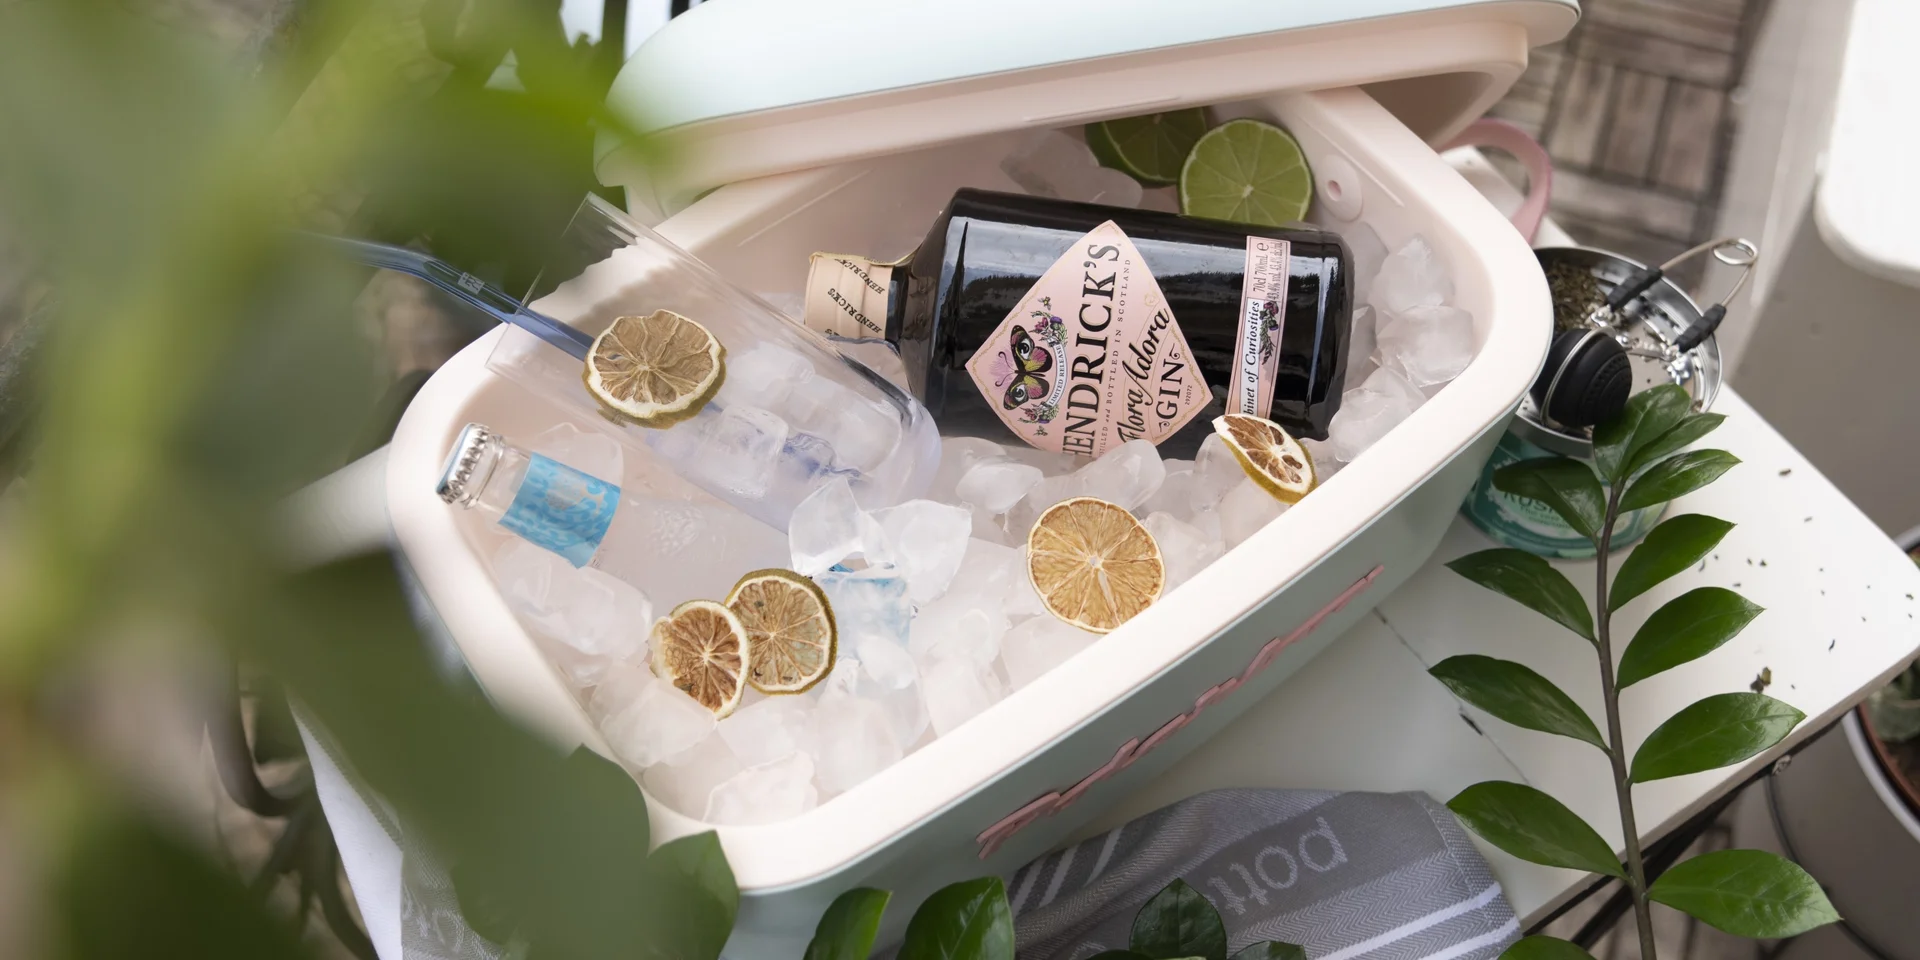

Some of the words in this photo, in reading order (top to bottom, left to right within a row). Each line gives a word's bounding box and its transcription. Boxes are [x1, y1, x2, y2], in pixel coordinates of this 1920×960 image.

[834, 258, 886, 295] HENDRICK
[1117, 259, 1131, 322] SCOTLAND
[827, 288, 882, 334] HENDRICK'S
[1114, 329, 1122, 343] IN
[1244, 301, 1260, 365] Curiosities
[1048, 379, 1064, 405] LIMITED
[1056, 345, 1065, 377] RELEASE
[1062, 244, 1120, 458] HENDRICK'S
[1244, 368, 1259, 383] of
[1107, 350, 1119, 404] BOTTLED
[1155, 358, 1185, 420] GIN
[1241, 387, 1256, 415] binet
[1099, 426, 1108, 456] STILLED
